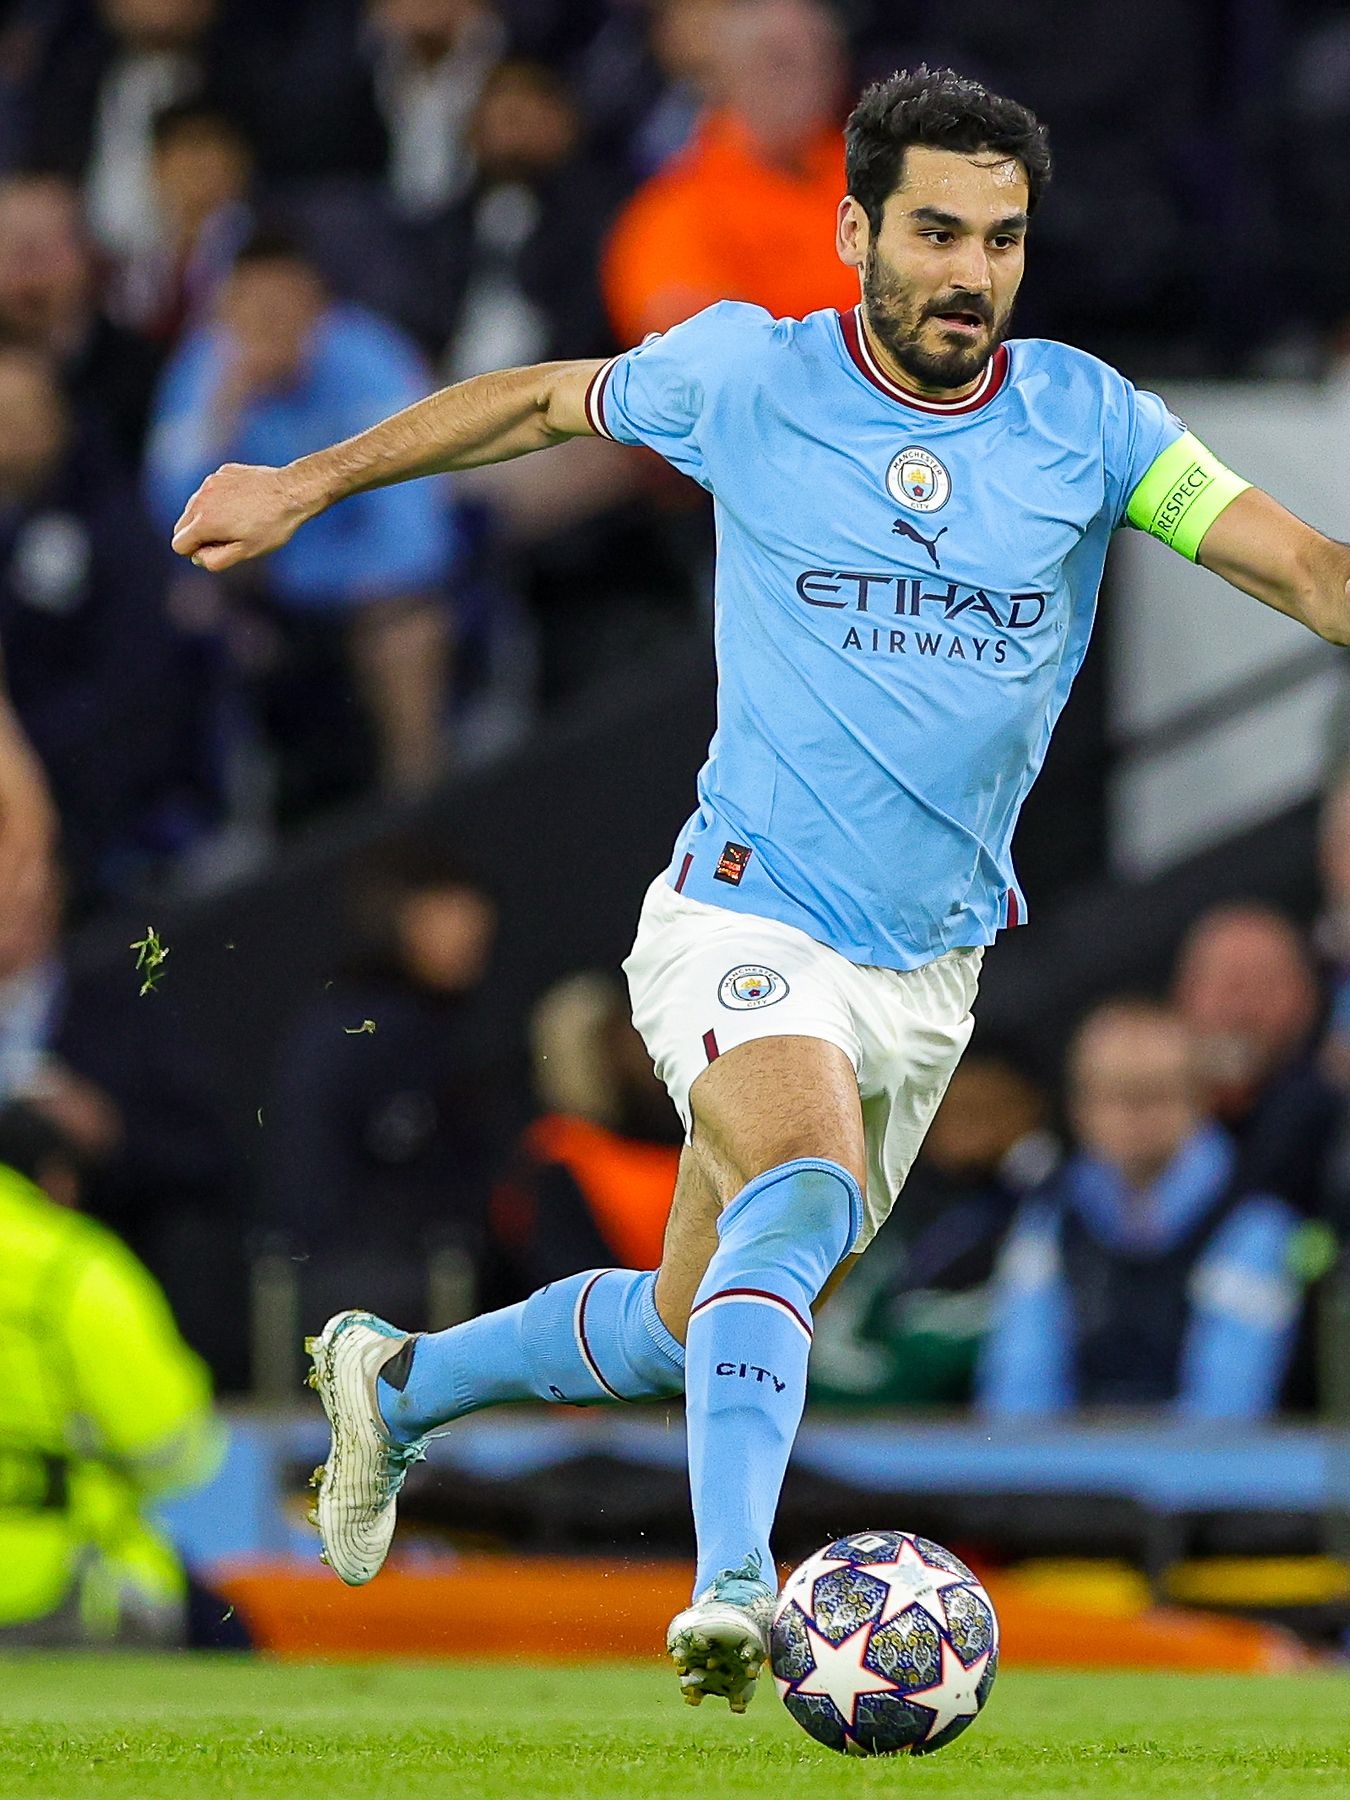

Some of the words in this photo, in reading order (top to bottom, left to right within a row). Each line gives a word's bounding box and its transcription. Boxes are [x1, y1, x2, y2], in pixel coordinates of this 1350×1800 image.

[893, 451, 943, 476] MANCHESTER
[910, 502, 929, 510] CITY
[1157, 466, 1208, 532] RESPECT
[796, 569, 1046, 629] ETIHAD
[842, 626, 1007, 664] AIRWAYS
[716, 1362, 786, 1393] CITY
